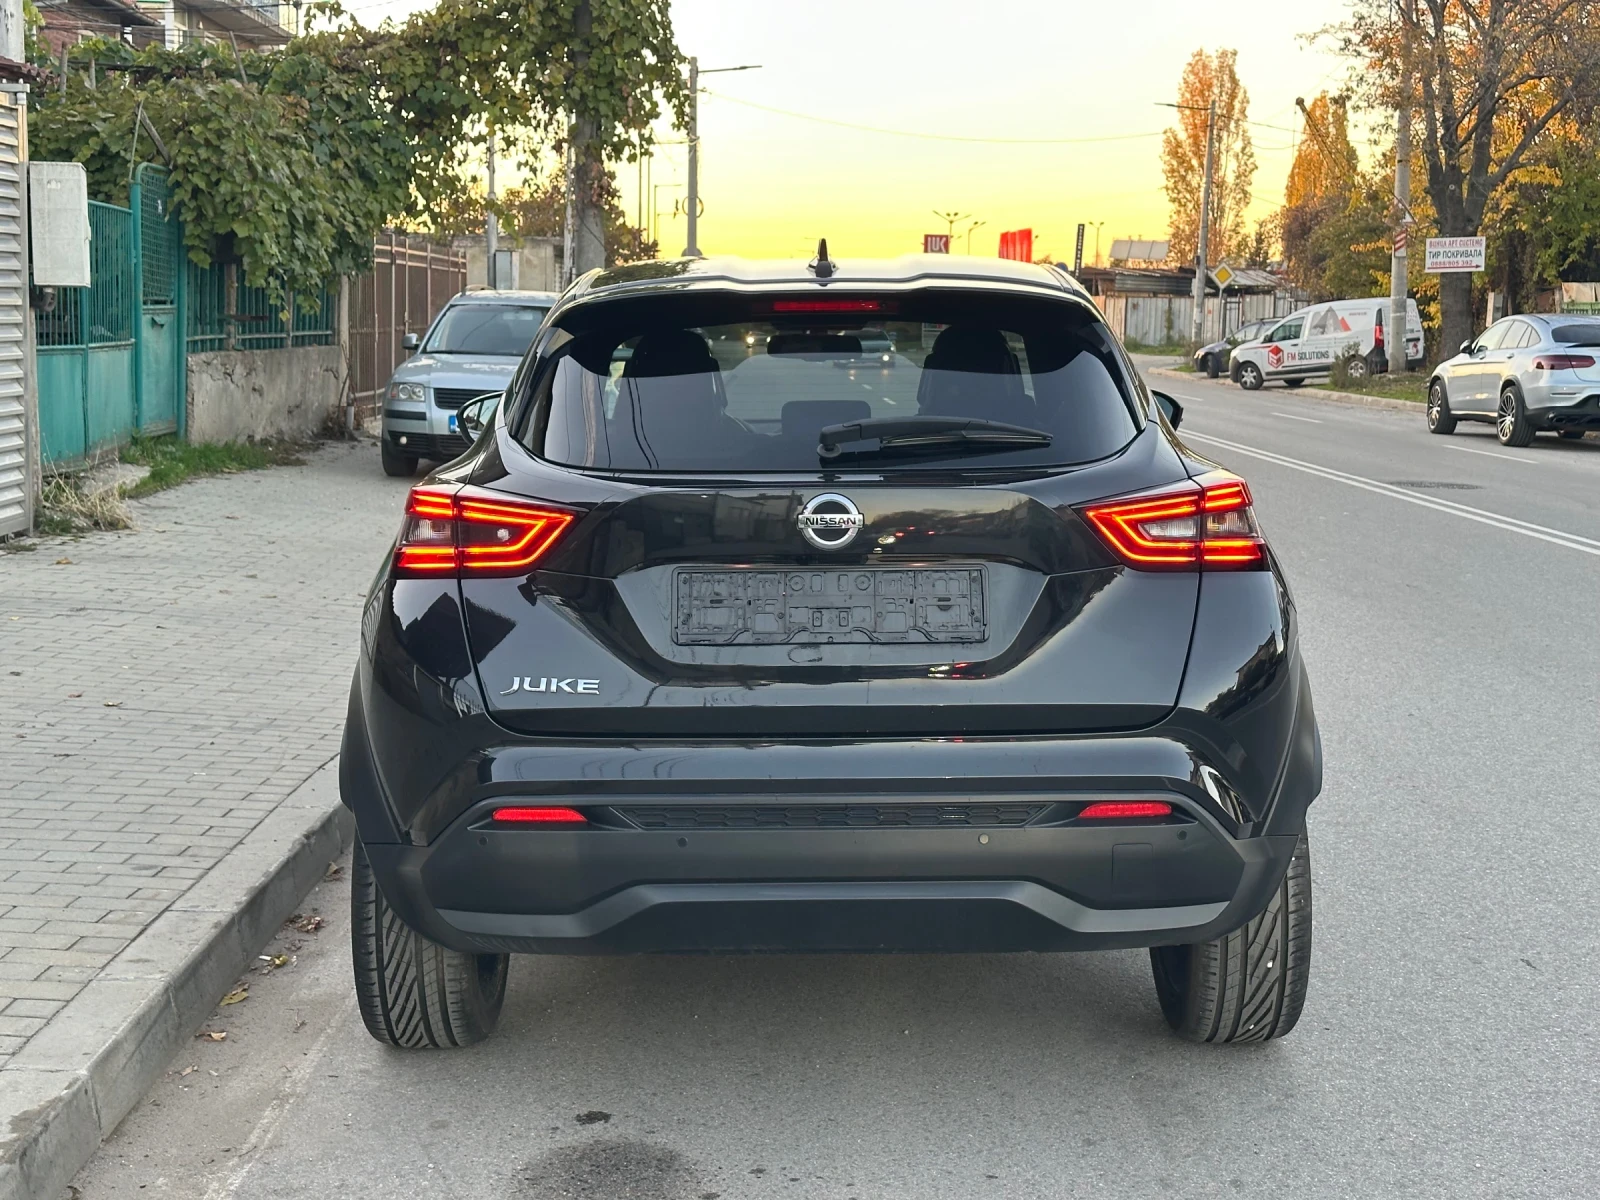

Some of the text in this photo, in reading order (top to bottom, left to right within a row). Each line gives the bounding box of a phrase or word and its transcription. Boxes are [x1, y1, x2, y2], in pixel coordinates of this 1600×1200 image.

[1428, 249, 1482, 259] ТИР ПОКРИВАЛА
[1287, 350, 1329, 361] FM SOLUTIONS
[805, 517, 857, 526] NISSAN
[500, 676, 600, 695] JUKE
